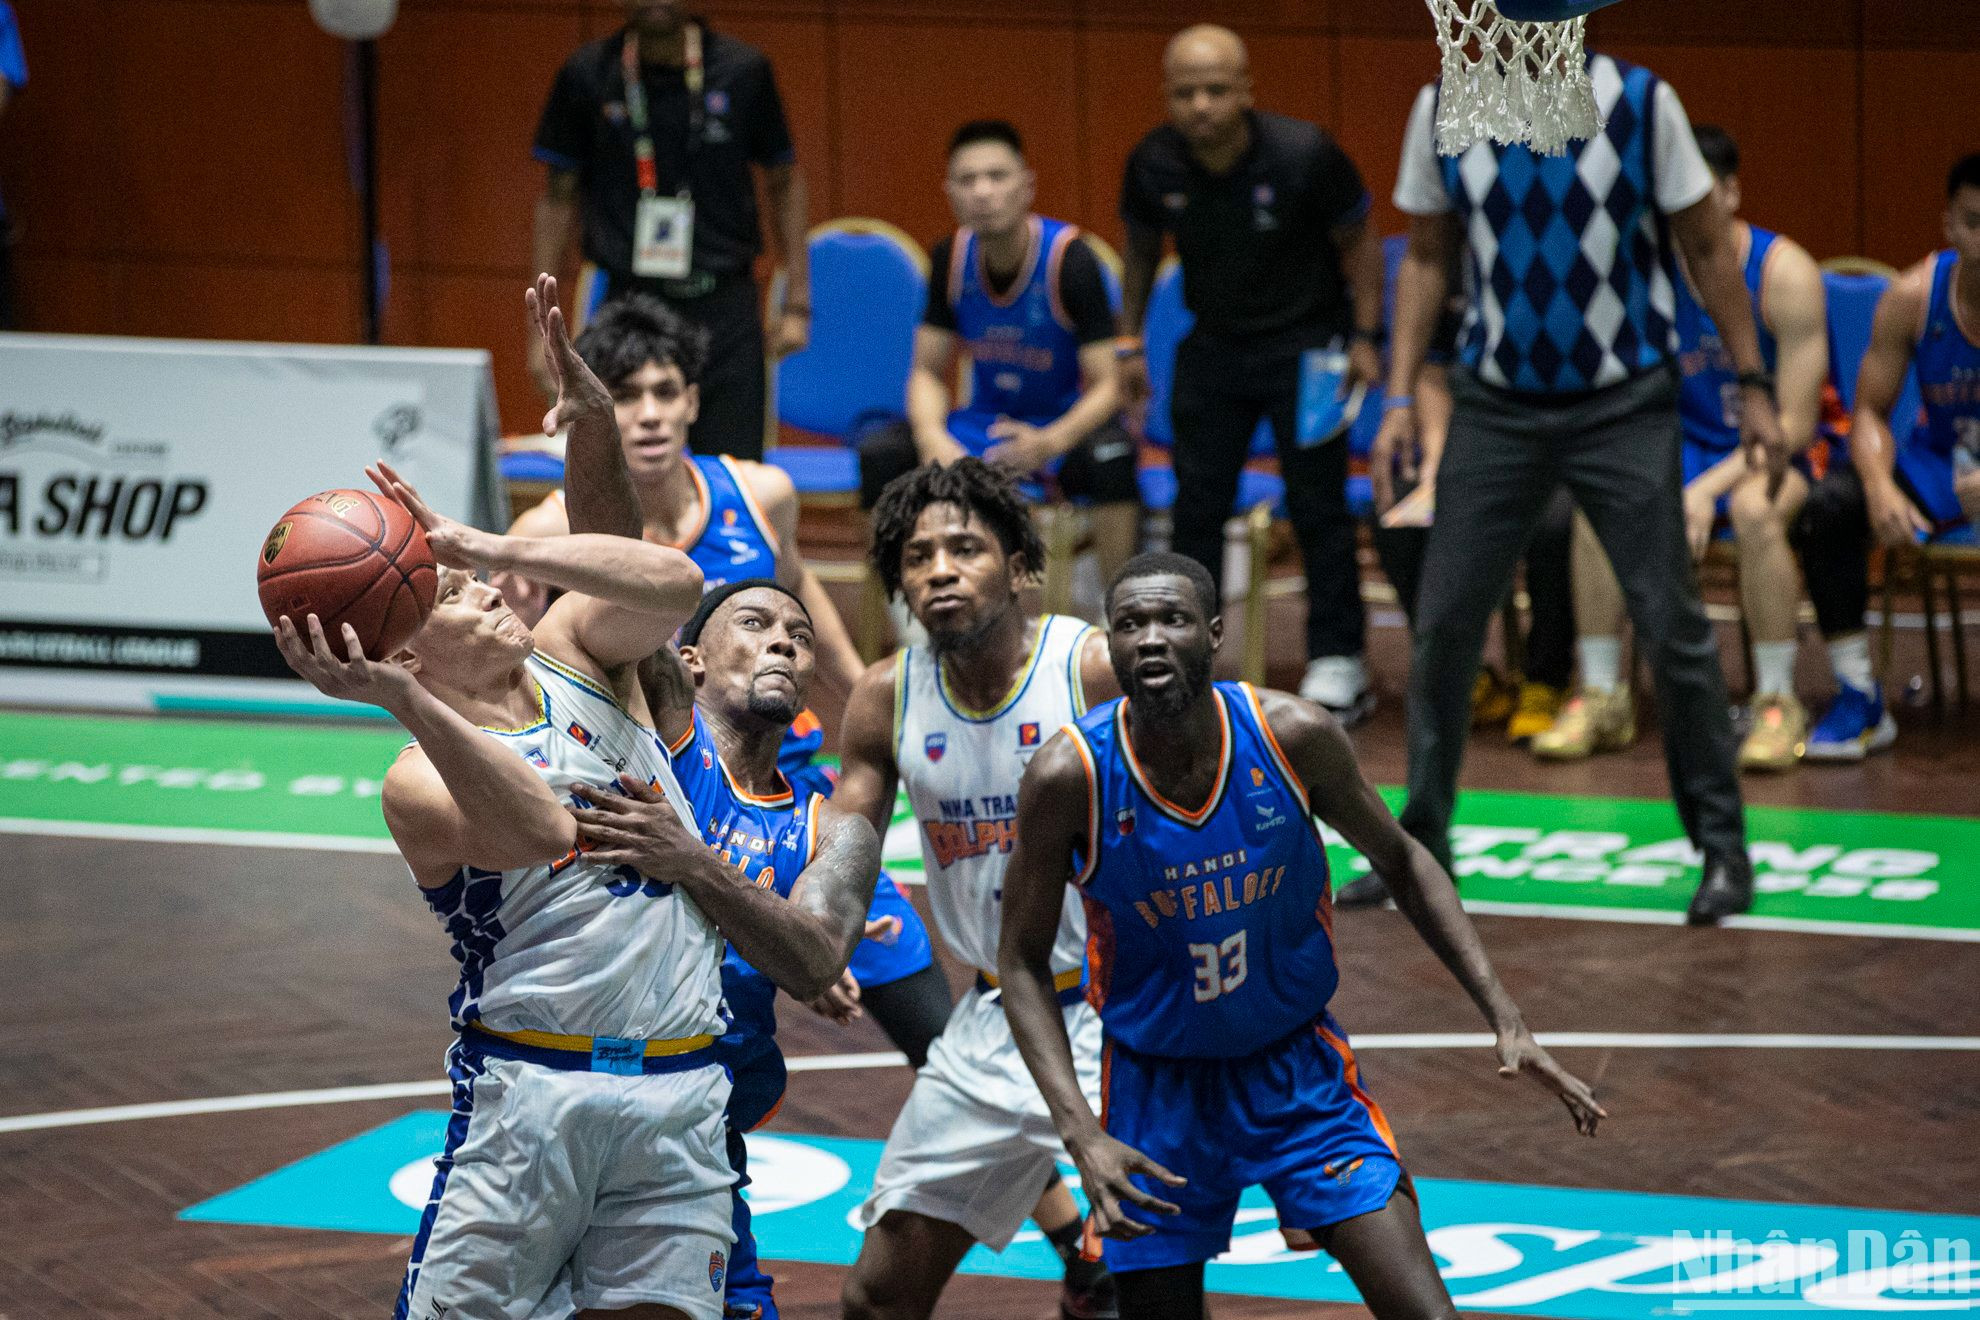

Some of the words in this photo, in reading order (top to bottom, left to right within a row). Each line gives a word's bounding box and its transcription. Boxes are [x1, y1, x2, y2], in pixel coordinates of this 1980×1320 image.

[37, 474, 209, 542] SHOP
[981, 795, 1017, 817] TRA
[922, 818, 1019, 869] DOLPH
[1163, 849, 1247, 881] HANOI
[1450, 825, 1940, 877] TRANG
[1188, 929, 1248, 1003] 33
